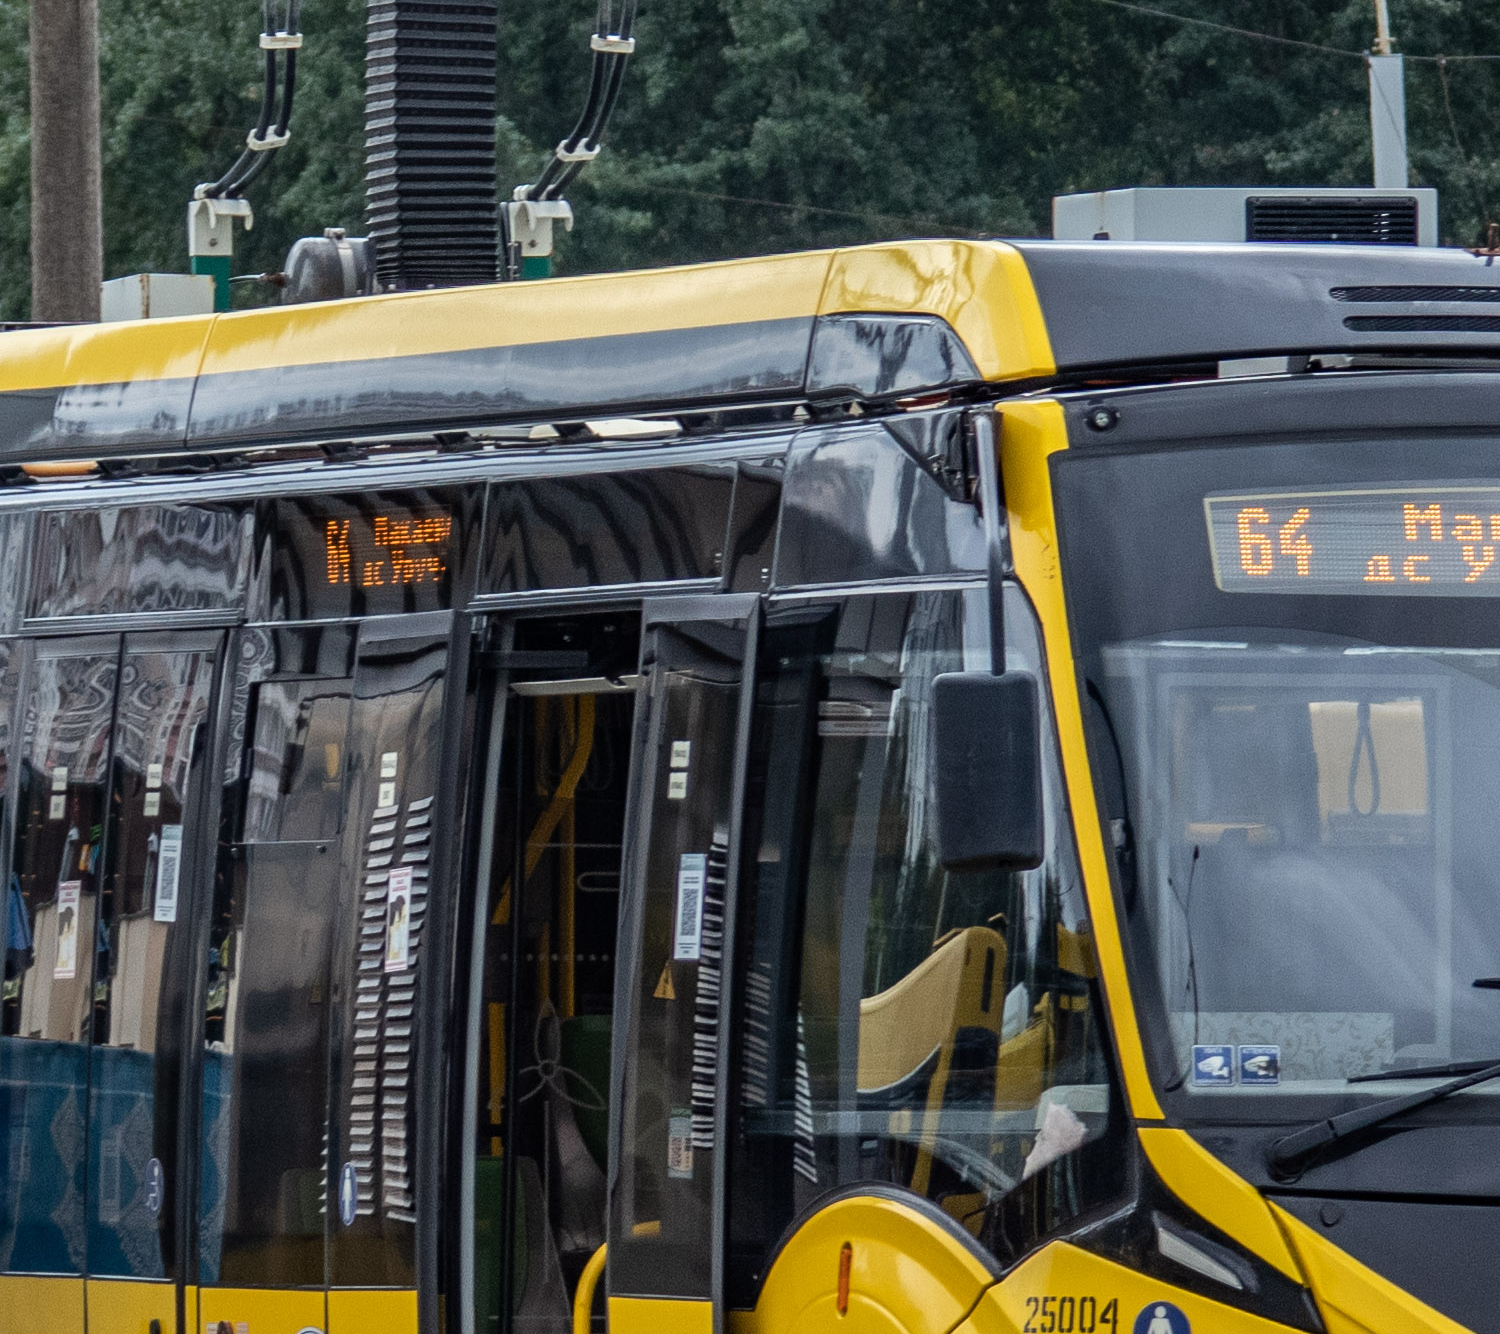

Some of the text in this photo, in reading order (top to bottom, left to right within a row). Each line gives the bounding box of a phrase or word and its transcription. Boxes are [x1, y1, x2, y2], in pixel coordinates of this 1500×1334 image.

[1237, 507, 1313, 577] 64
[1363, 554, 1432, 583] дс
[1023, 1296, 1118, 1334] 25004
